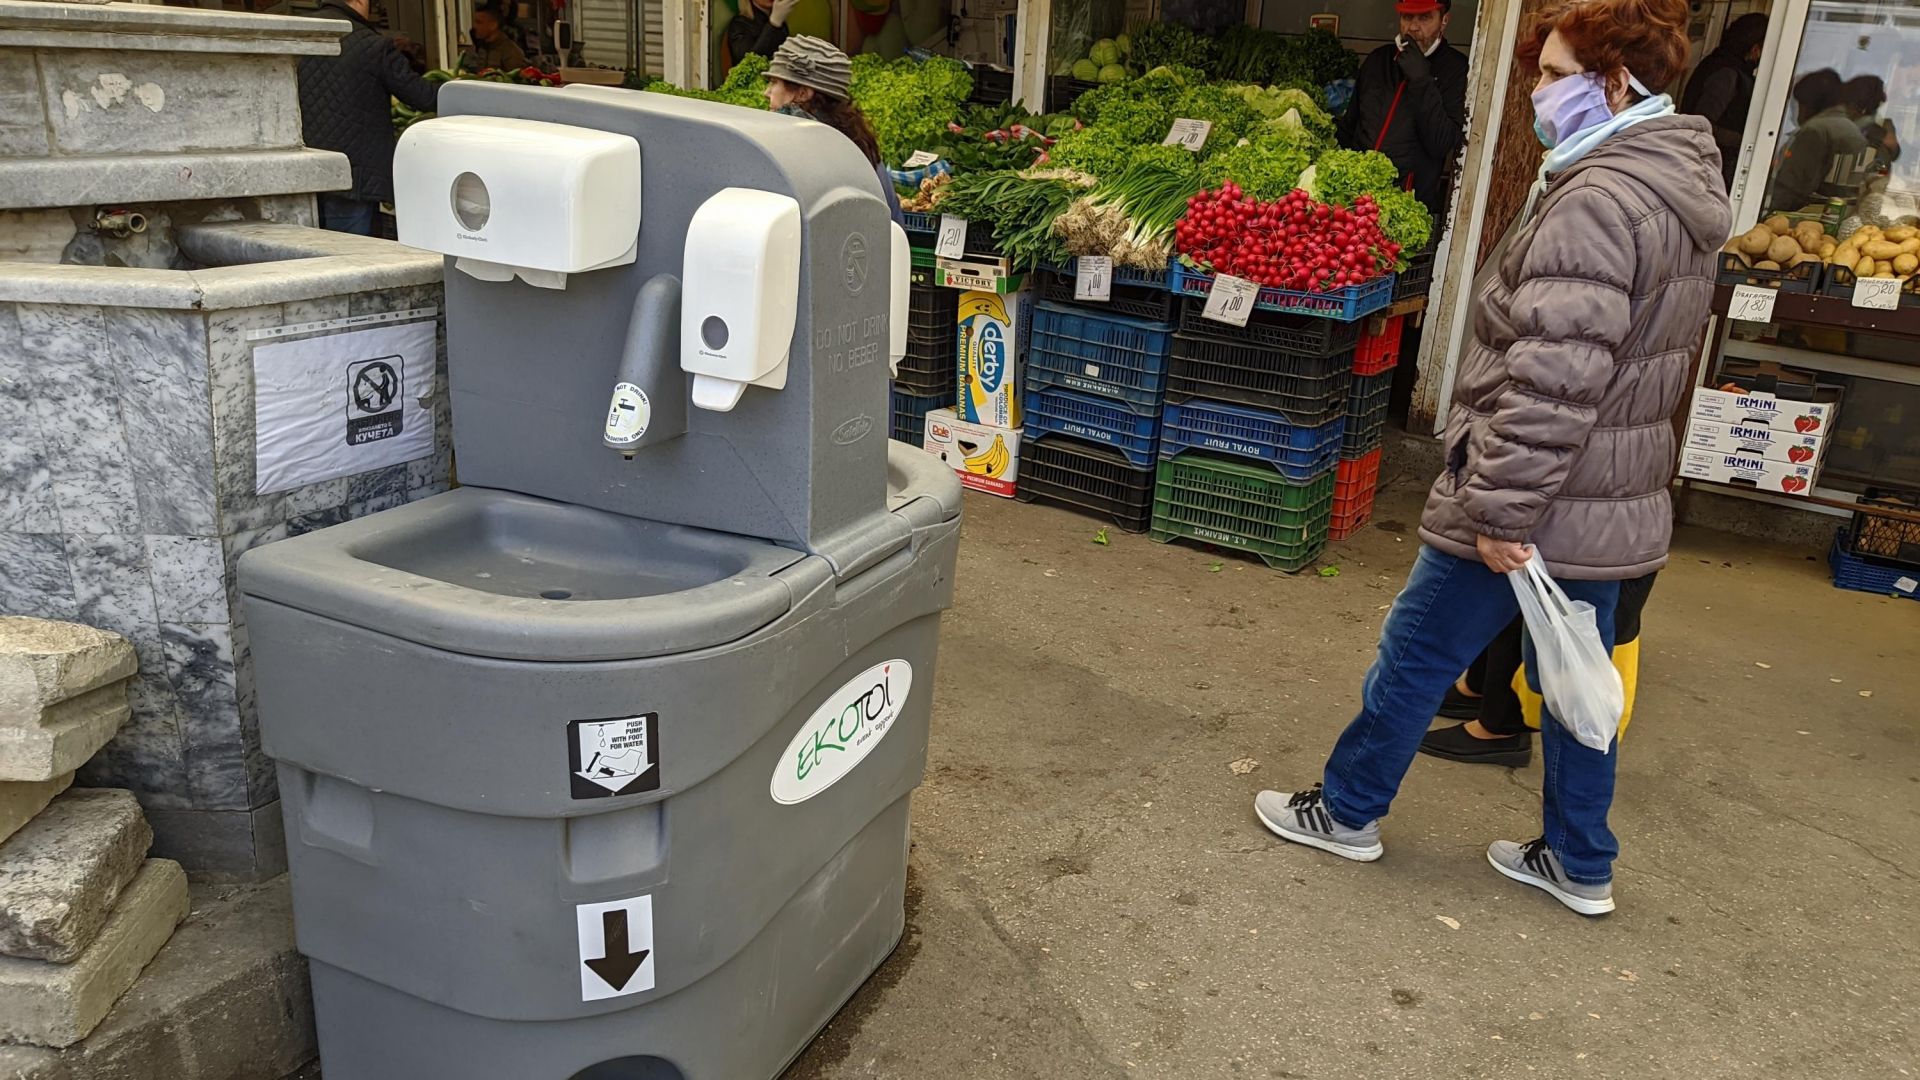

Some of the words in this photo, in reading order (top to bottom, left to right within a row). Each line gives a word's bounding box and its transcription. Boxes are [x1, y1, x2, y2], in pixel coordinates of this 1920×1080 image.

[955, 276, 992, 287] VICTORY
[816, 327, 832, 350] DO
[838, 321, 858, 346] NOT
[863, 313, 890, 339] DRINK
[959, 324, 967, 372] PREMIUM
[828, 352, 843, 375] NO
[848, 342, 879, 369] BEBER
[979, 326, 1005, 388] derby
[631, 426, 645, 439] ONLY
[932, 424, 949, 437] Dole
[1063, 422, 1085, 434] FRUIT
[1087, 428, 1111, 440] ROYAL
[355, 427, 394, 443] КУЧЕТА
[1203, 438, 1230, 449] FRUIT
[1231, 442, 1260, 455] ROYAL
[626, 720, 643, 728] PUSH
[625, 727, 643, 735] PUMP
[611, 735, 627, 743] WITH
[628, 733, 644, 741] FOOT
[610, 742, 622, 750] FOR
[623, 739, 644, 749] WATER
